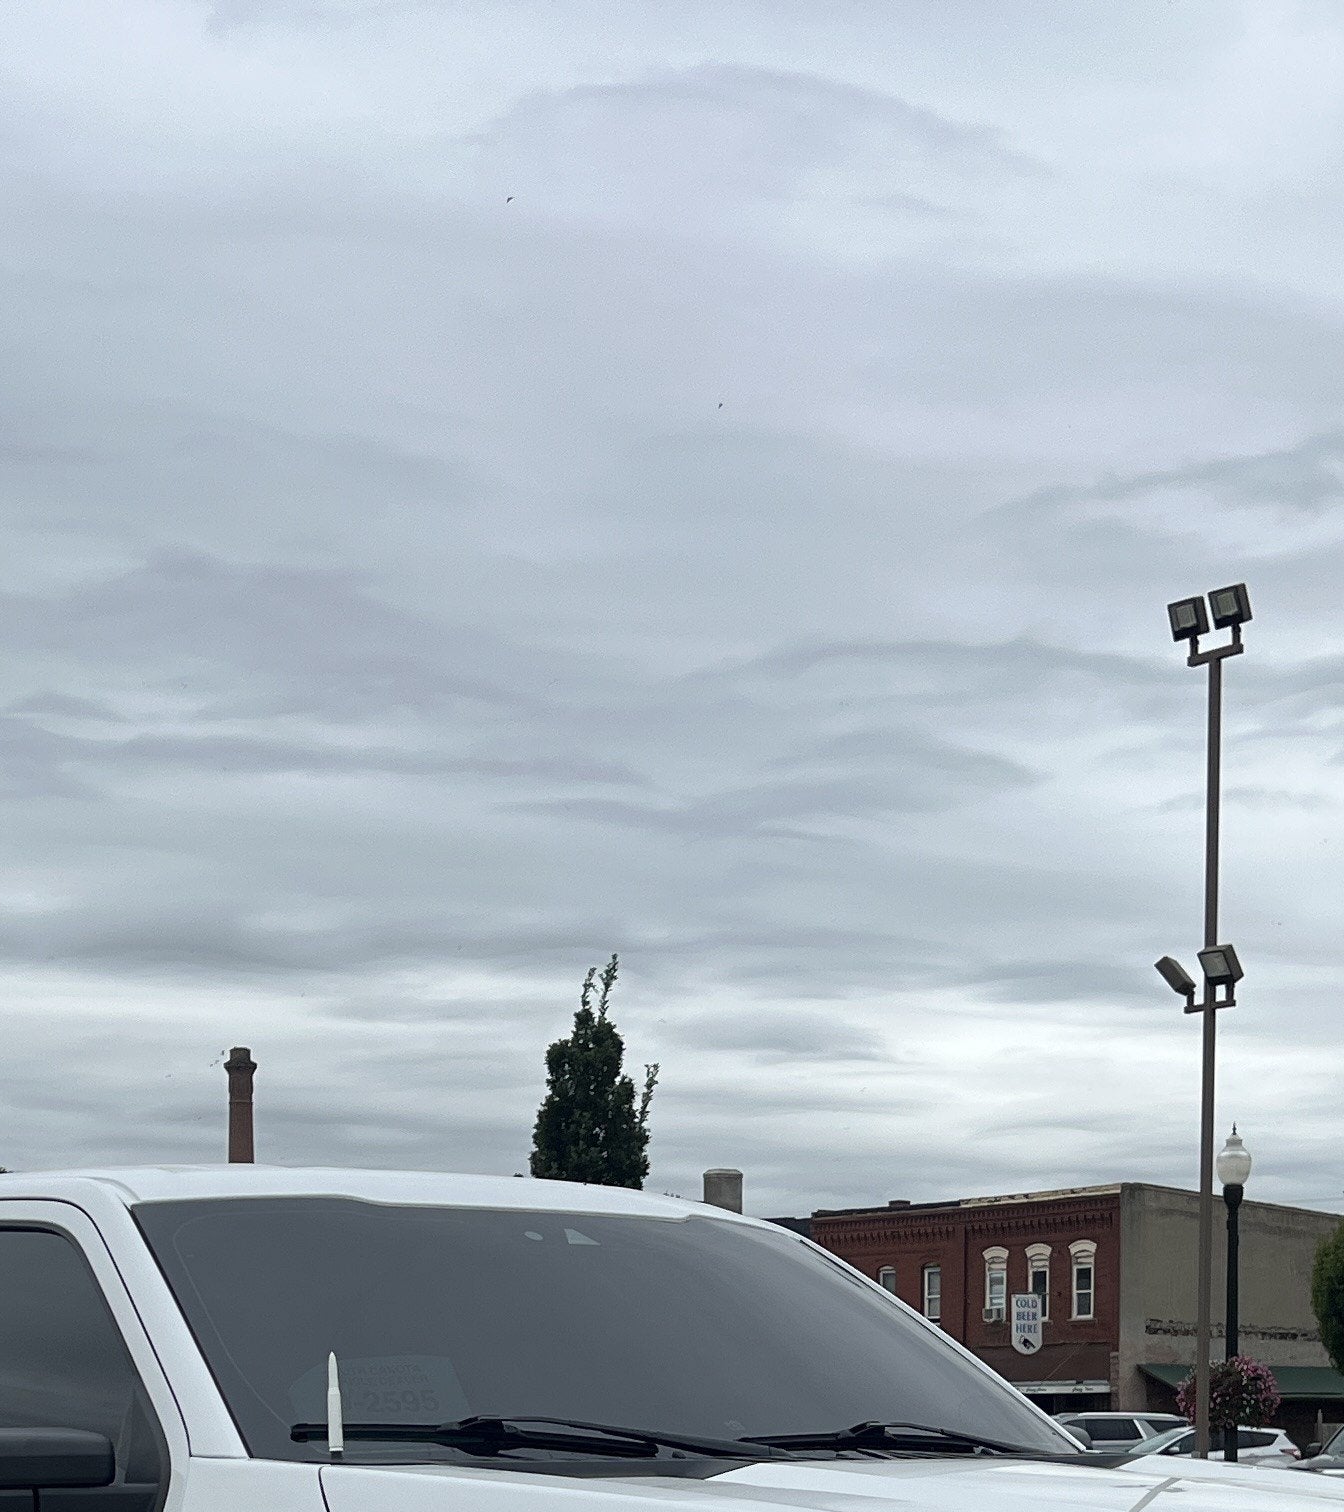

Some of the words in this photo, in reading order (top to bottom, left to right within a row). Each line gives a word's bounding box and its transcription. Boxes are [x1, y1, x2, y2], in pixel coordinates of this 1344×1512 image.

[1016, 1299, 1038, 1309] COLD
[1016, 1311, 1038, 1321] BEER
[1016, 1323, 1038, 1334] HERE
